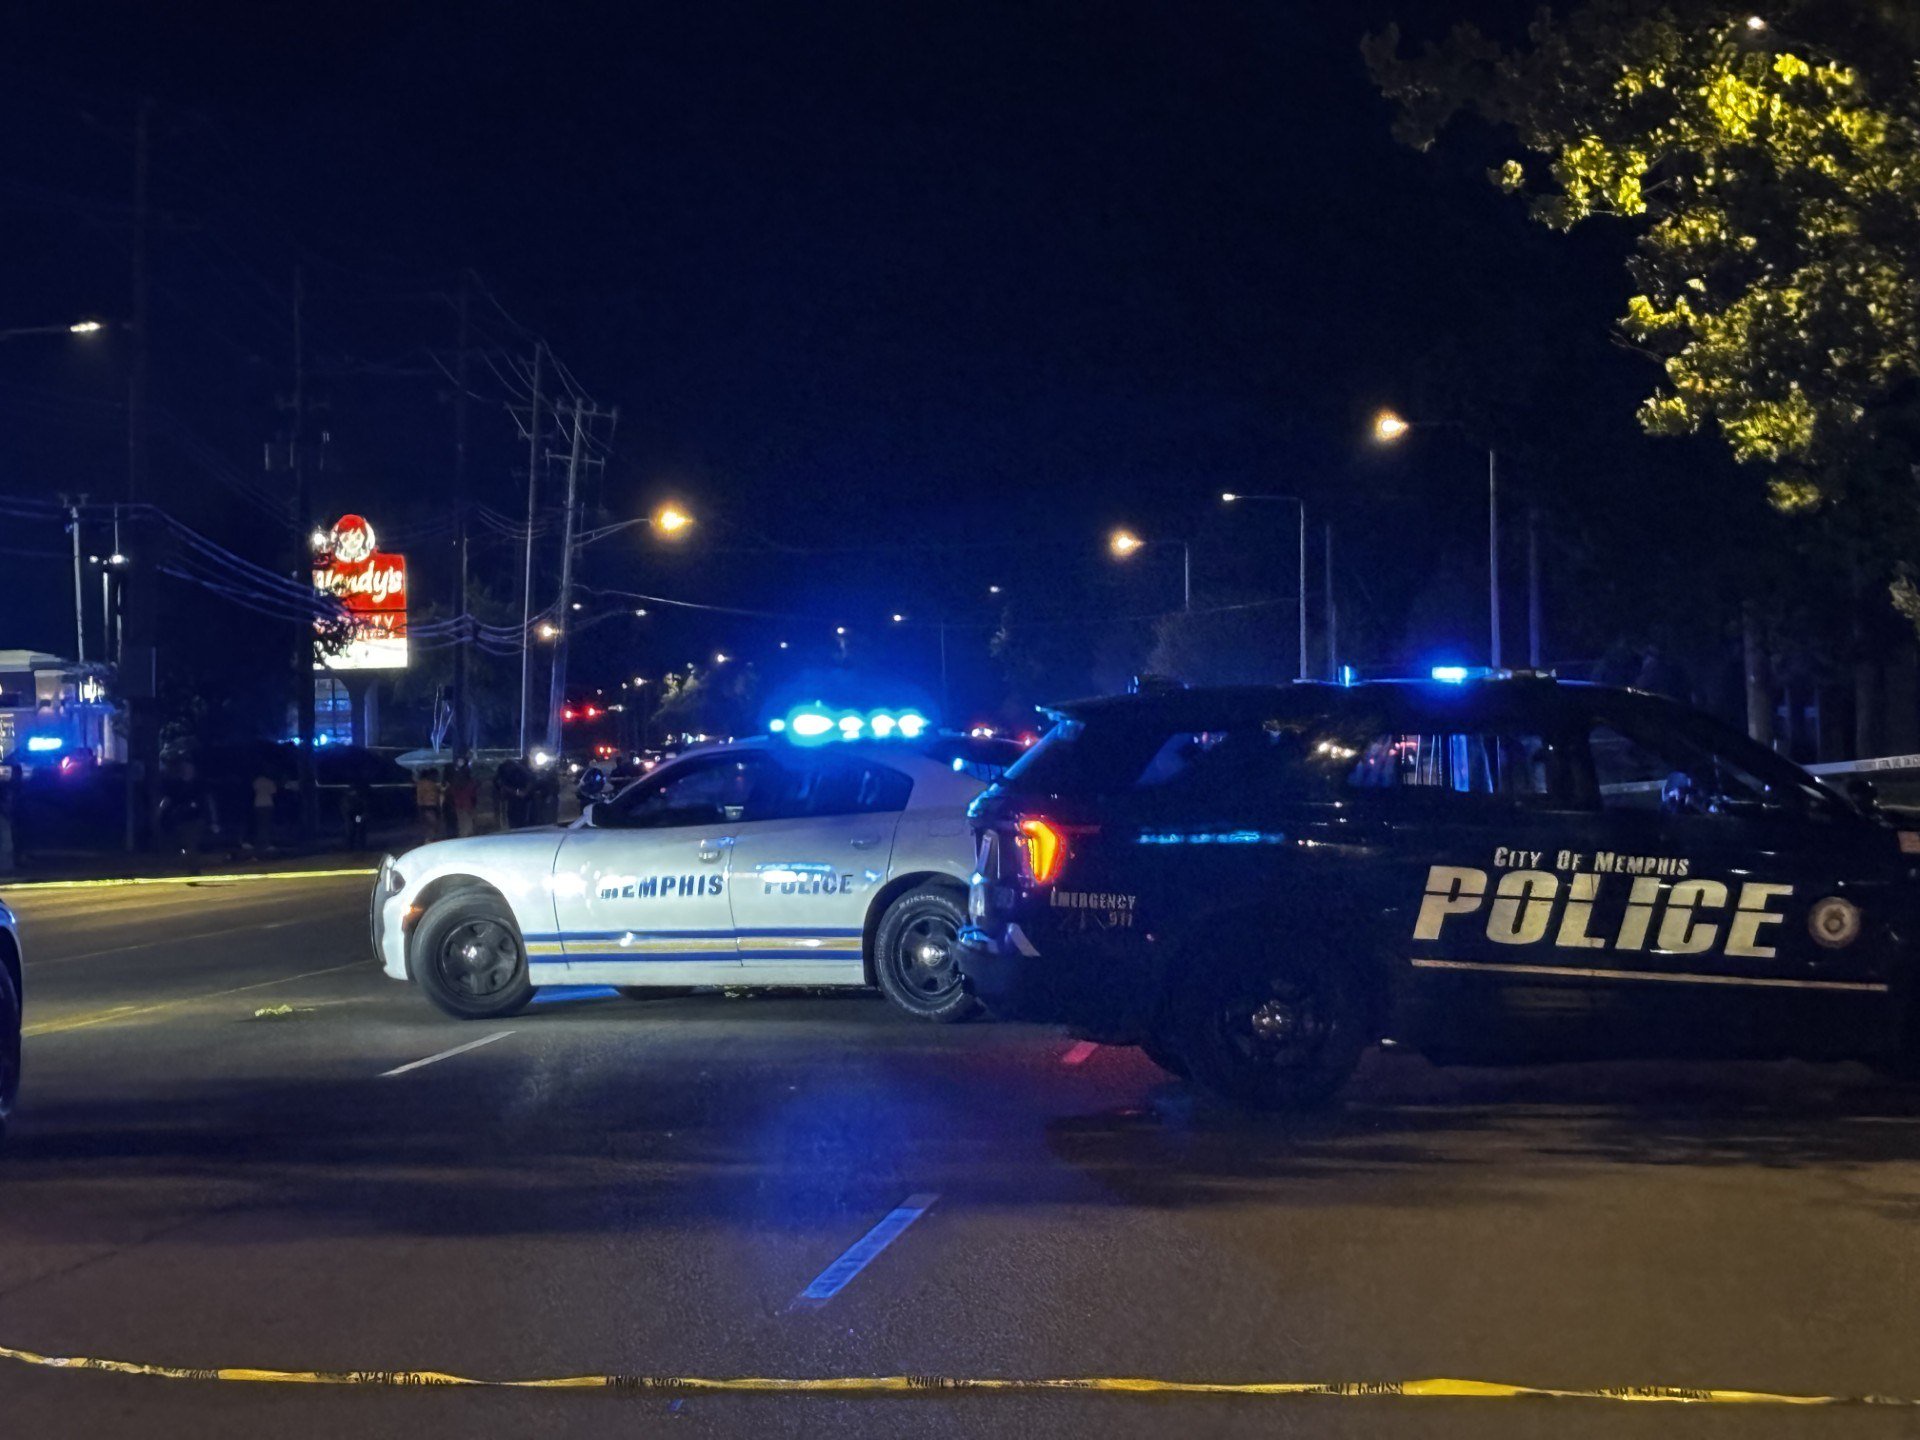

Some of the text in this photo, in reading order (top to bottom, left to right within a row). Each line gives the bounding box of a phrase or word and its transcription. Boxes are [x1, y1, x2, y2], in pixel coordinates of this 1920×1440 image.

[1494, 847, 1690, 876] CITY OF MEMPHIS
[1413, 865, 1794, 958] POLICE
